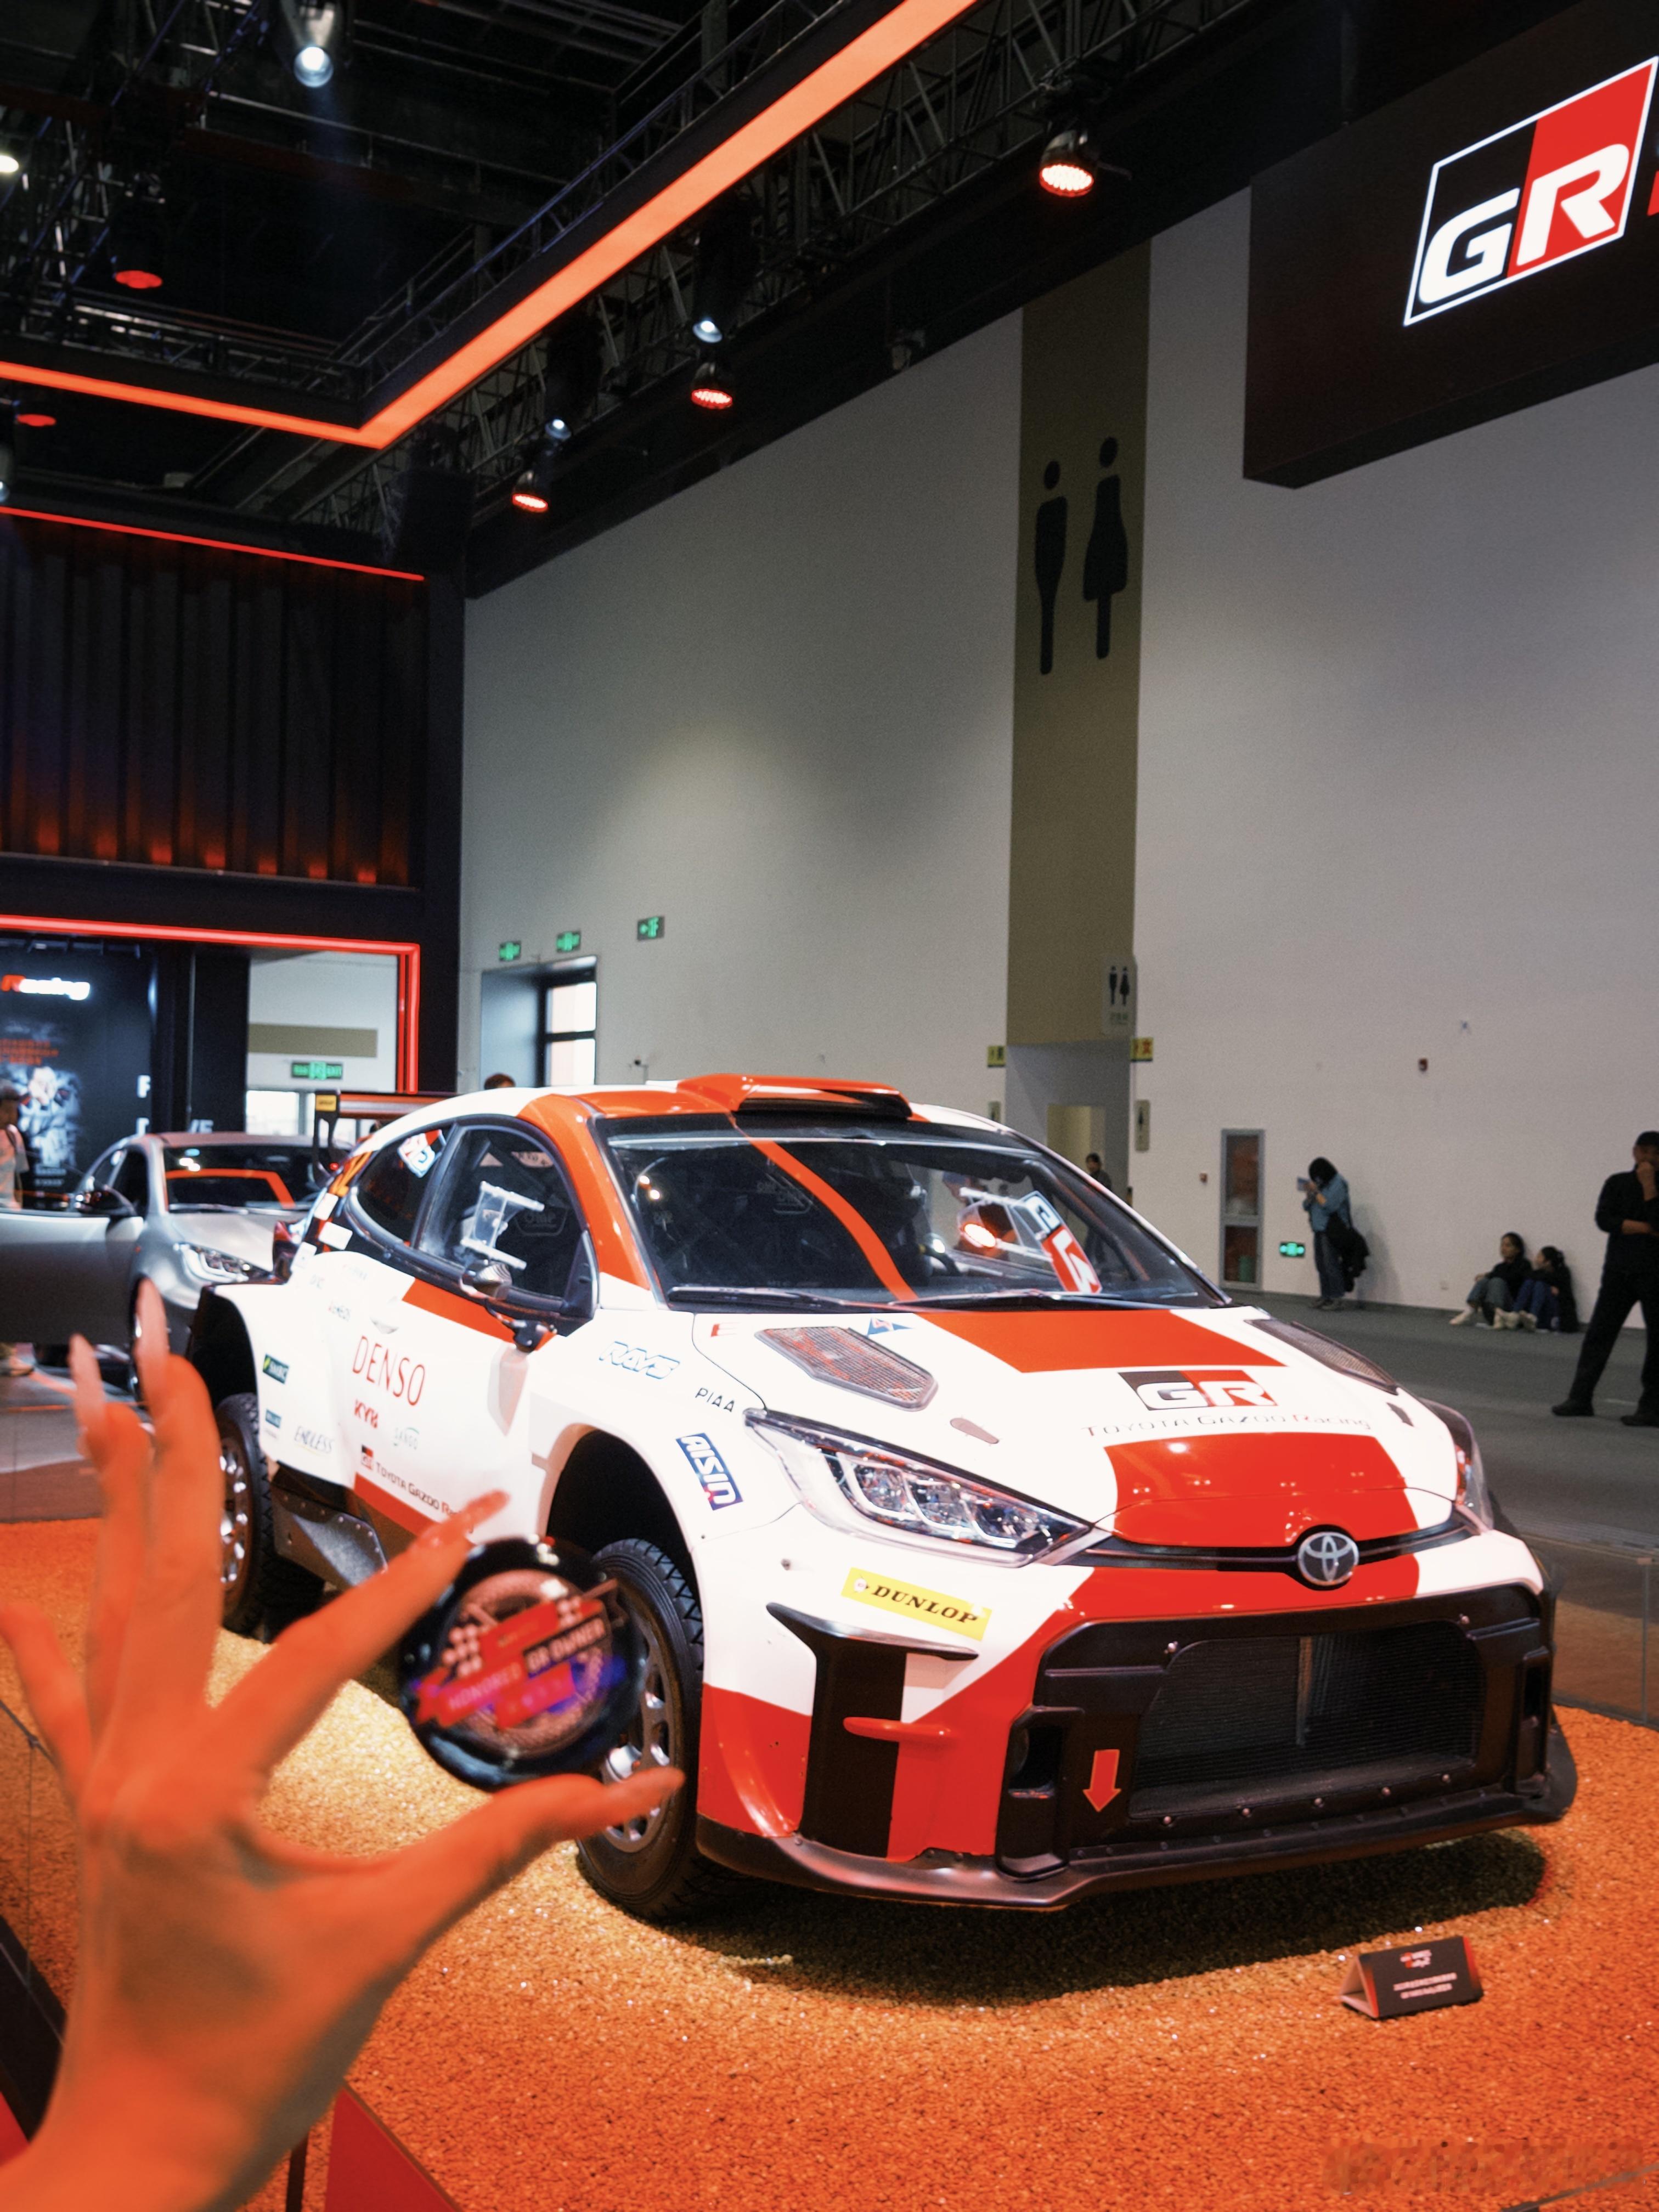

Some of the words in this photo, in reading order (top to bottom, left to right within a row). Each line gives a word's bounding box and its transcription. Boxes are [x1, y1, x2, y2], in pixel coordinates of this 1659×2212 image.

[1419, 143, 1630, 304] GR
[352, 1335, 426, 1406] DENSO
[598, 1340, 681, 1380] RAYS
[695, 1387, 735, 1412] PIAA
[1135, 1380, 1278, 1409] GR
[1081, 1417, 1189, 1437] TOYOTA
[1197, 1414, 1287, 1426] GAZOO
[1292, 1414, 1372, 1430] Racing
[376, 1460, 407, 1490] TOYOTA
[408, 1482, 440, 1510] GAZOO
[680, 1435, 737, 1505] AISIN
[871, 1584, 978, 1623] DUNLOP
